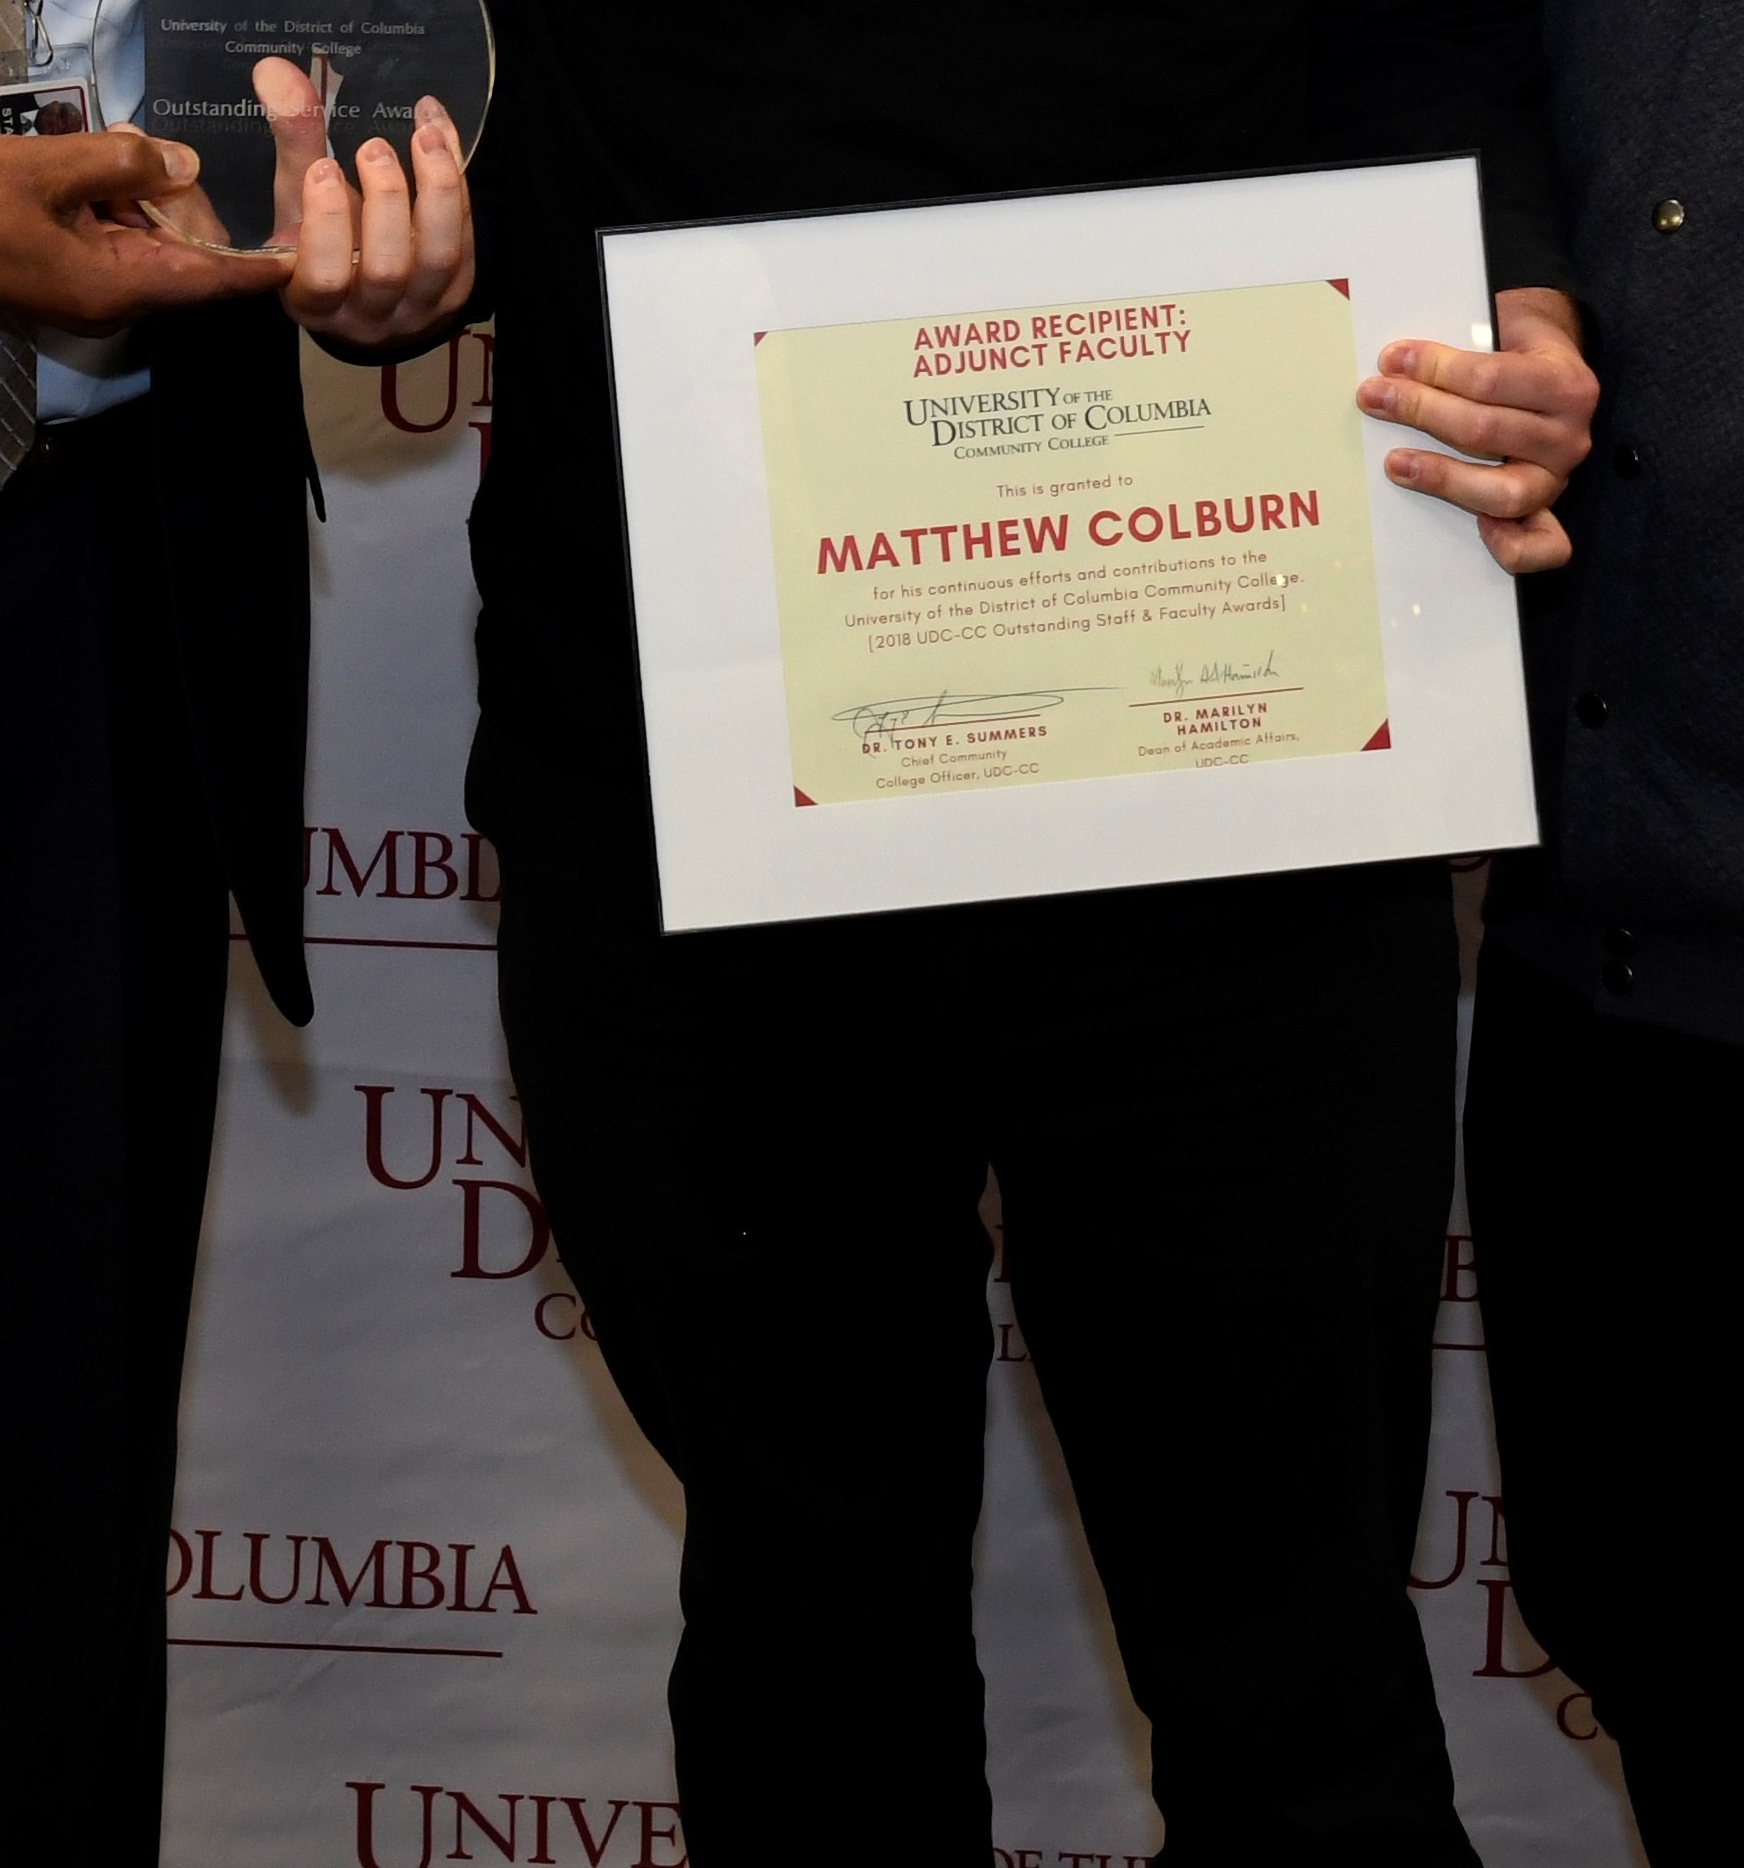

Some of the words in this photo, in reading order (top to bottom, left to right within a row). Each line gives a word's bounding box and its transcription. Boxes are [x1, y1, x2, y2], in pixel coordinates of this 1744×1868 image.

[161, 18, 227, 34] University
[255, 20, 277, 32] the
[284, 20, 334, 33] District
[340, 21, 354, 34] of
[360, 22, 425, 35] Columbia
[224, 40, 305, 55] Community
[311, 41, 362, 57] College
[152, 98, 277, 121] Outstanding
[914, 319, 1021, 350] AWARD
[1031, 304, 1187, 339] RECIPIENT:
[913, 343, 1048, 378] ADJUNCT
[1059, 330, 1191, 364] FACULTY
[903, 387, 1061, 427] UNIVERSITY
[1063, 392, 1081, 405] OF
[1084, 389, 1113, 403] THE
[931, 413, 1044, 447] DISTRICT
[1051, 413, 1078, 431] OF
[1085, 397, 1212, 431] COLUMBIA
[953, 440, 1042, 460] COMMUNITY
[1048, 434, 1110, 452] COLLEGE
[996, 483, 1028, 499] This
[1032, 482, 1044, 496] is
[1049, 474, 1112, 497] granted
[1117, 474, 1134, 487] to
[817, 514, 1069, 575] MATTHEW
[1088, 490, 1320, 547] COLBURN
[873, 586, 895, 601] for
[901, 584, 923, 599] his
[928, 578, 1014, 596] continuous
[1019, 570, 1072, 587] efforts
[1077, 565, 1107, 581] and
[1112, 558, 1216, 578] contributions
[1221, 555, 1237, 567] to
[1243, 550, 1267, 564] the
[844, 609, 922, 627] University
[926, 604, 942, 620] of
[949, 603, 974, 618] the
[979, 599, 1036, 615] District
[1041, 594, 1057, 609] of
[1063, 588, 1139, 606] Columbia
[1144, 578, 1233, 599] Community
[917, 625, 987, 645] UDC-CC
[992, 615, 1091, 638] Outstanding
[1096, 609, 1136, 627] Staff
[1142, 608, 1153, 622] &
[1159, 603, 1216, 621] Faculty
[1162, 711, 1189, 723] DR.
[1195, 702, 1268, 720] MARILYN
[862, 742, 887, 754] DR.
[893, 736, 938, 751] TONY
[946, 733, 960, 745] E.
[967, 725, 1048, 744] SUMMERS
[1177, 717, 1262, 736] HAMILTON
[900, 755, 935, 768] Chief
[939, 749, 1008, 765] Community
[1138, 745, 1170, 757] Dean
[1174, 740, 1187, 753] of
[1191, 736, 1251, 750] Academic
[875, 775, 926, 789] College
[930, 768, 981, 784] Officer,
[983, 762, 1040, 778] UDC-CC
